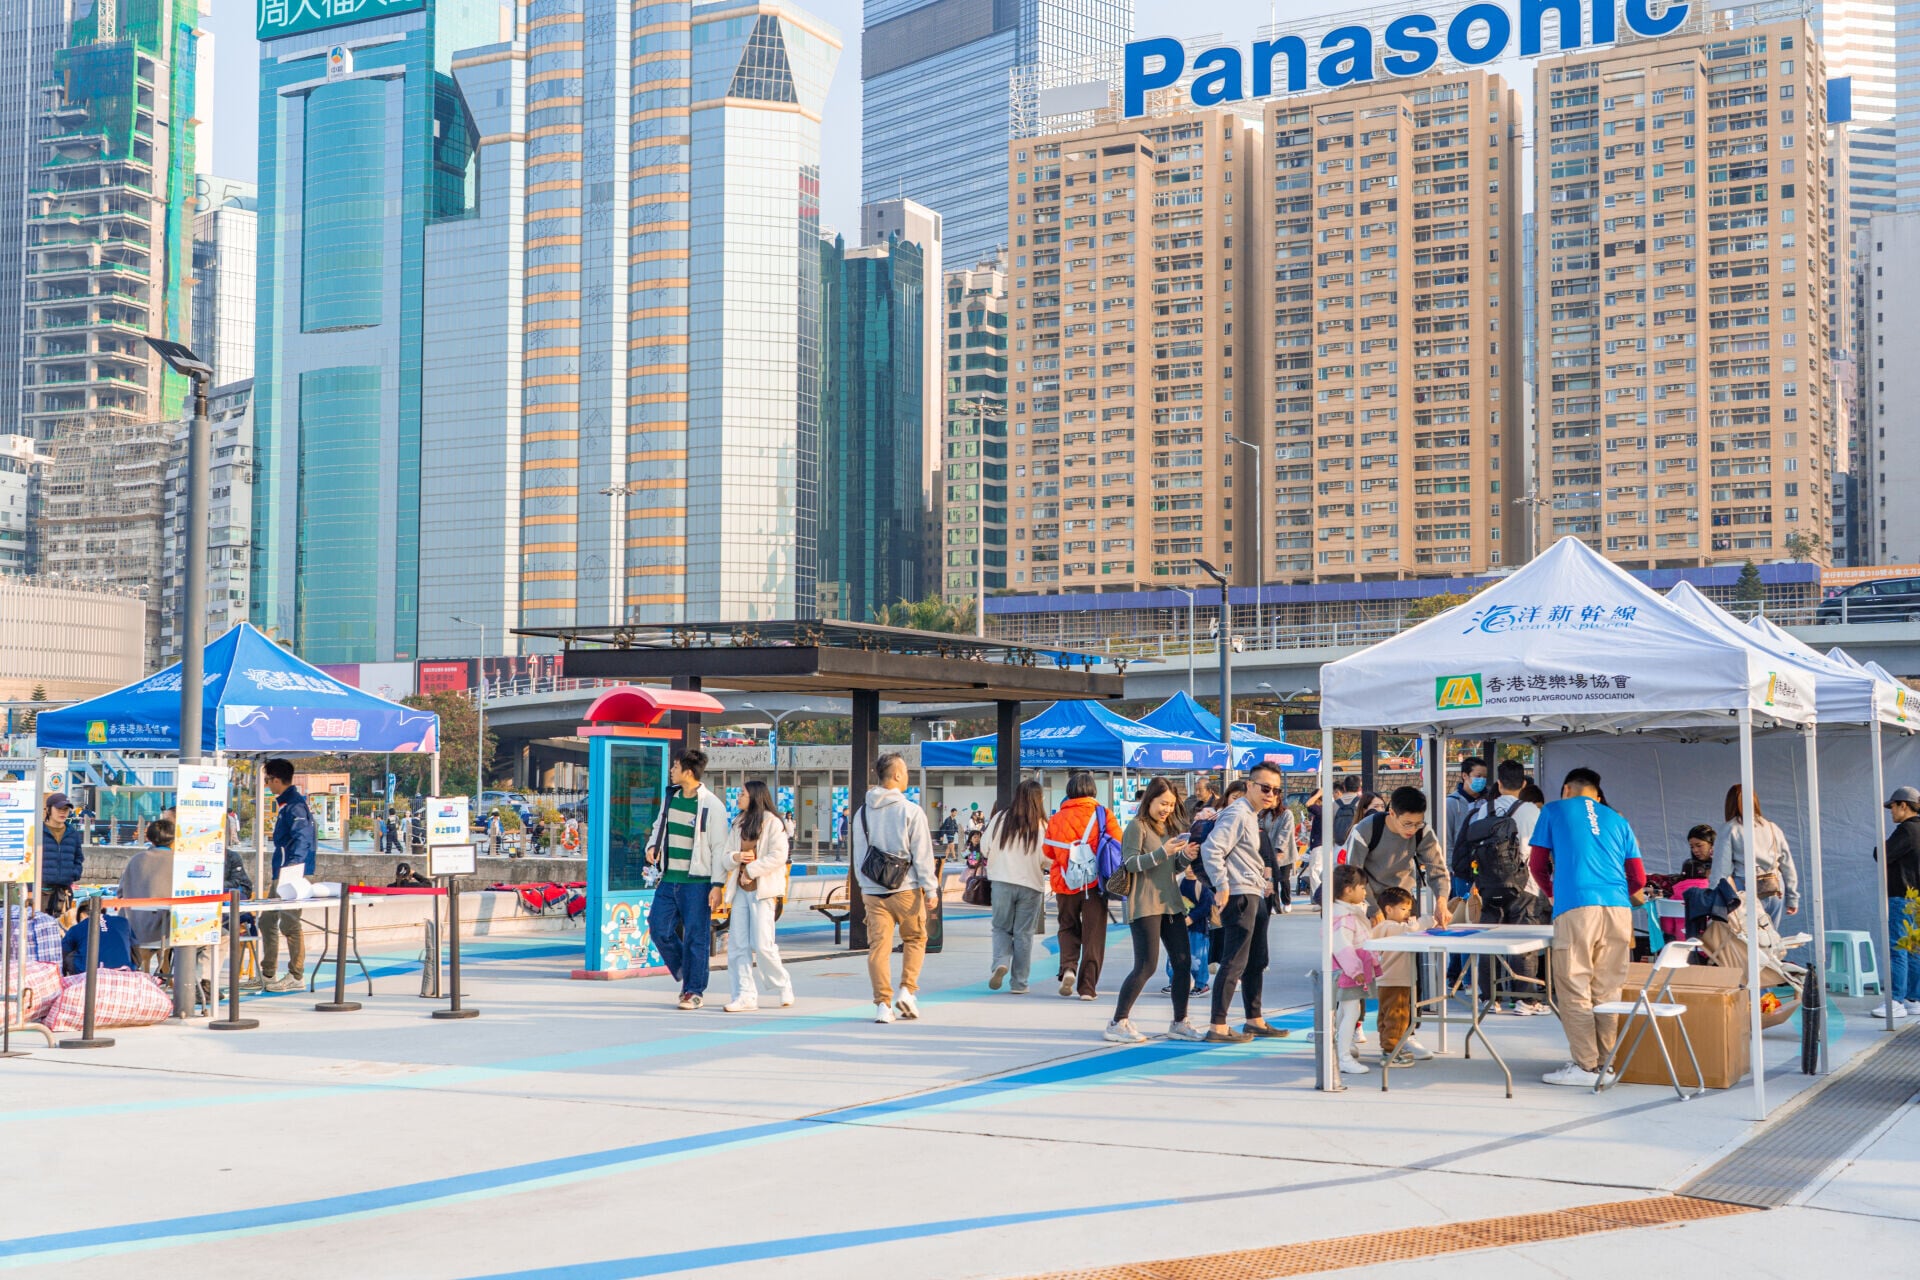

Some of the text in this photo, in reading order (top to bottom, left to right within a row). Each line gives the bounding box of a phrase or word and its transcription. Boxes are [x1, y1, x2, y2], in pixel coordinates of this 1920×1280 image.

[258, 0, 414, 31] 周大福
[1124, 0, 1690, 118] Panasonic
[1463, 604, 1637, 634] 海洋新幹線
[1486, 673, 1632, 693] 香港遊樂場協會
[1485, 692, 1635, 705] HONG KONG PLAYGROUND ASSOCIATION
